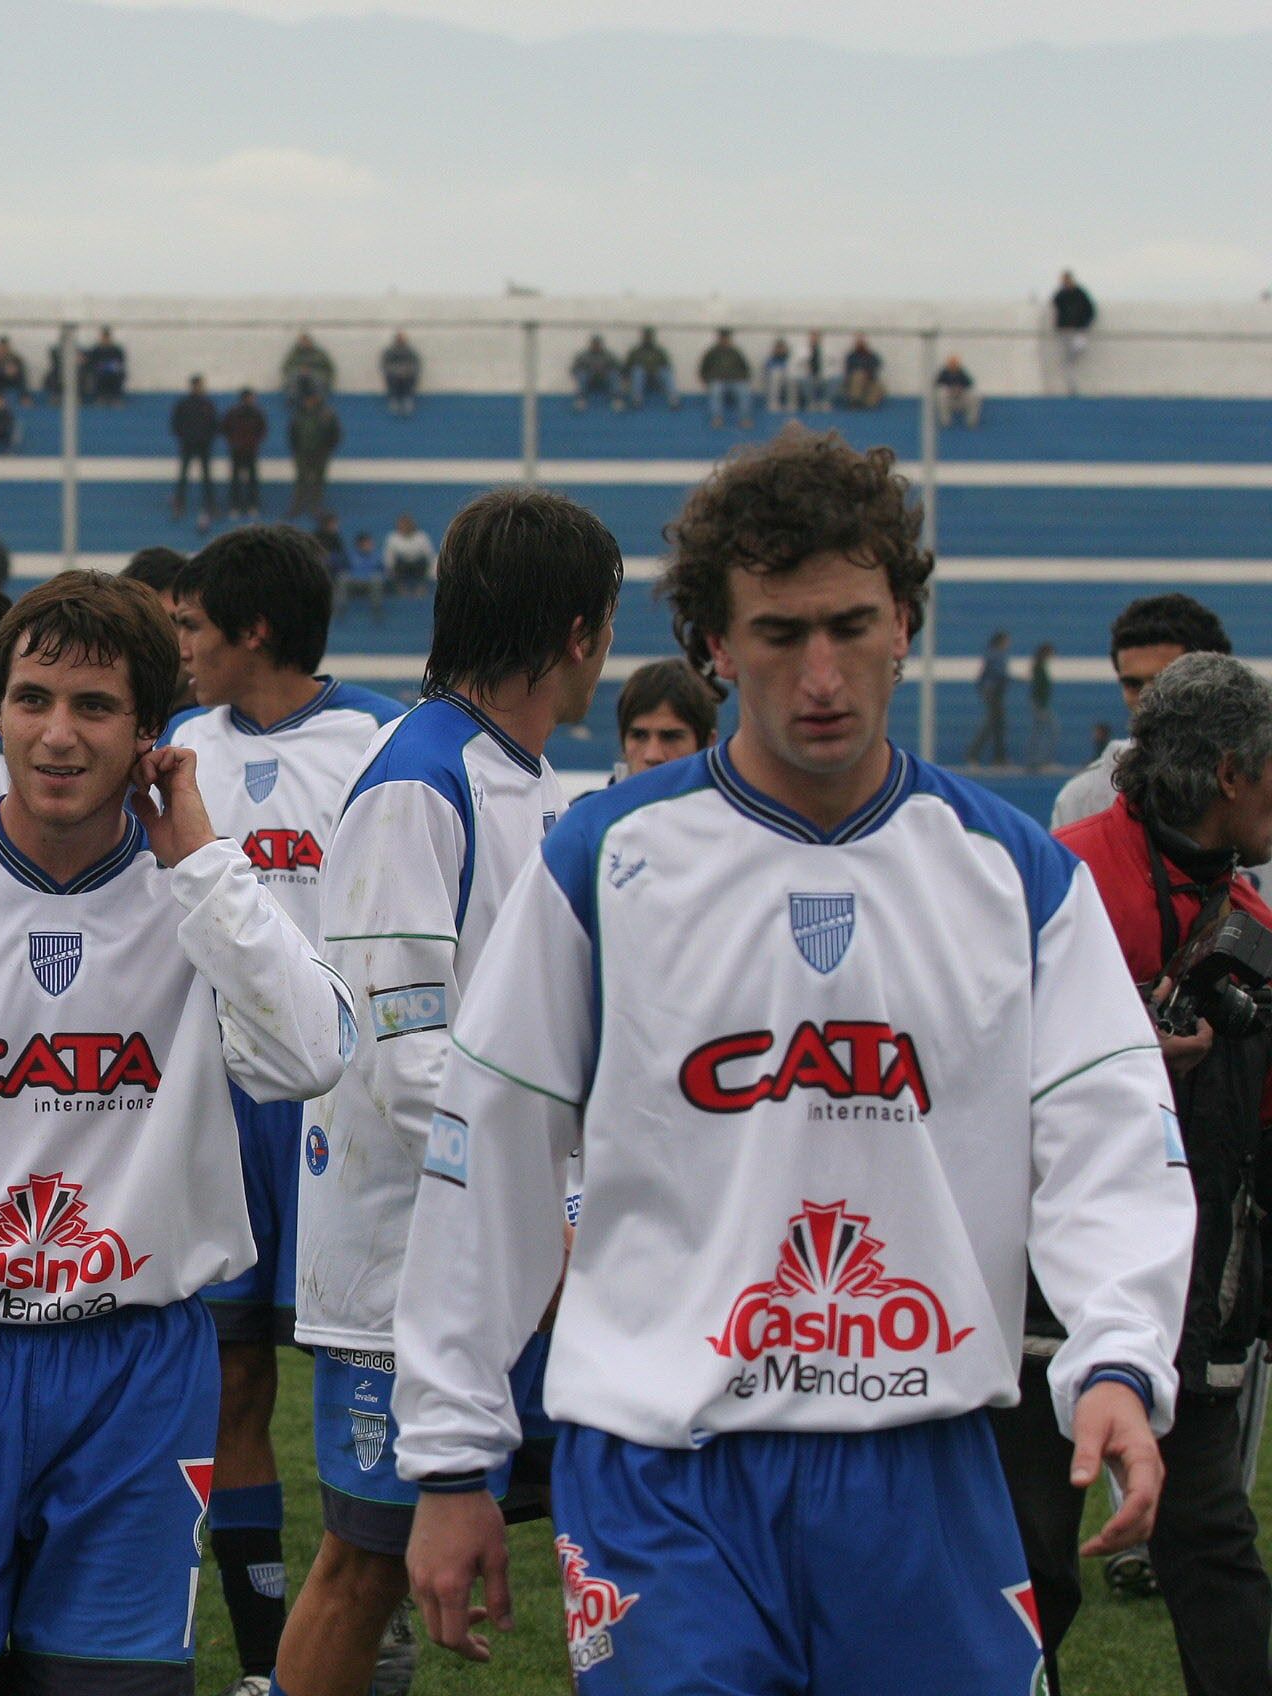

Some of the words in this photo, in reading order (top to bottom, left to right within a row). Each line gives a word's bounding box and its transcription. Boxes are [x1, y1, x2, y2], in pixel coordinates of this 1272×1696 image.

[242, 829, 323, 872] ATA
[679, 1020, 932, 1115] CATA
[34, 1096, 154, 1113] internaciona
[808, 1103, 924, 1122] internaci
[764, 1354, 928, 1401] Mendoza
